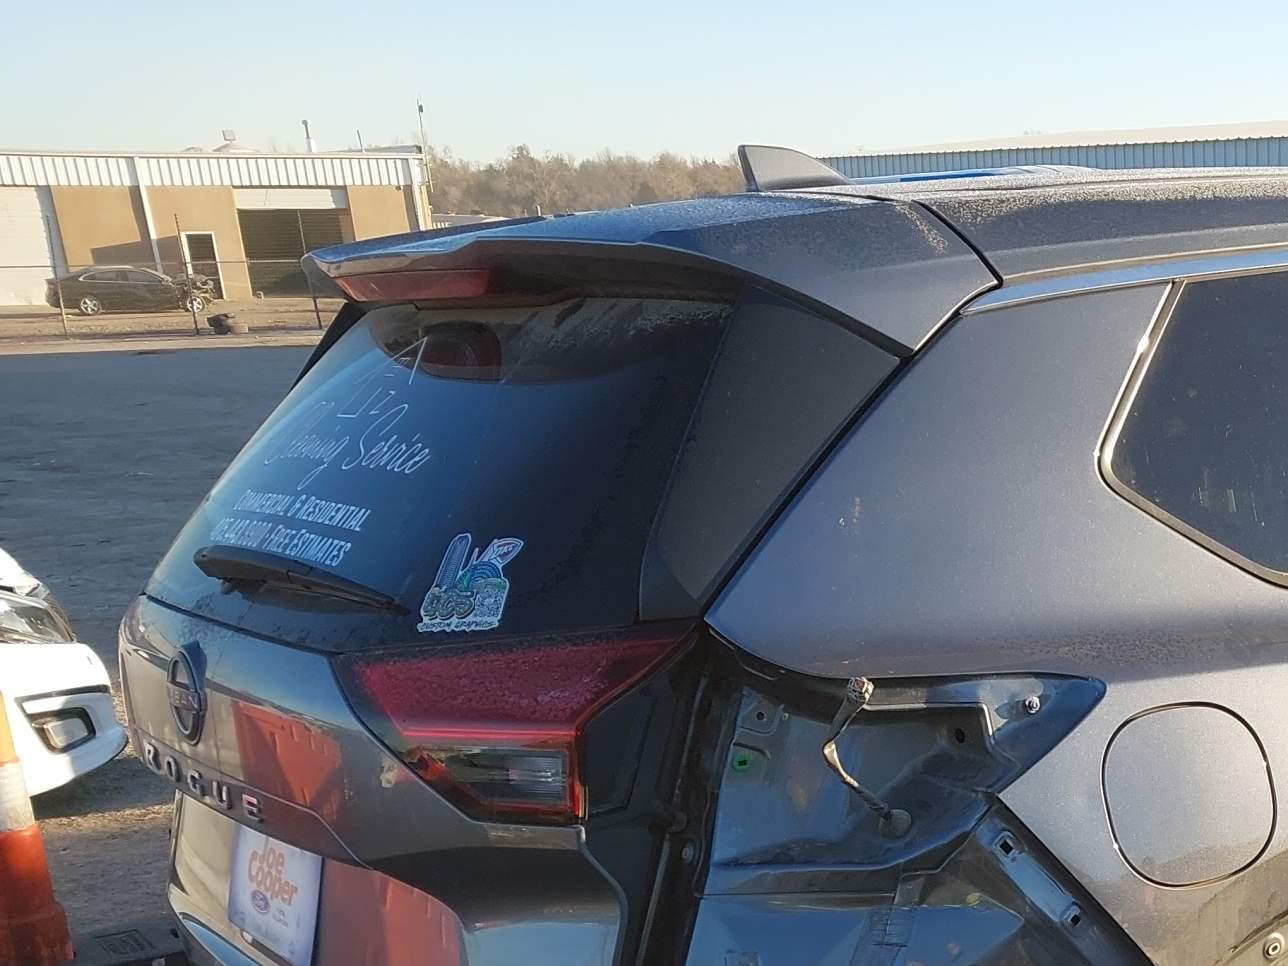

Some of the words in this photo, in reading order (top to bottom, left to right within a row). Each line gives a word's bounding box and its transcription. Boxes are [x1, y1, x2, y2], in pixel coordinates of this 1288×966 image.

[342, 402, 431, 474] Service
[296, 496, 372, 532] RESIDENTIAL
[262, 524, 298, 553] FREE
[285, 528, 352, 567] ESTIMATES
[143, 738, 265, 824] ROGUE
[248, 850, 298, 907] Cooper
[257, 838, 285, 876] Joe
